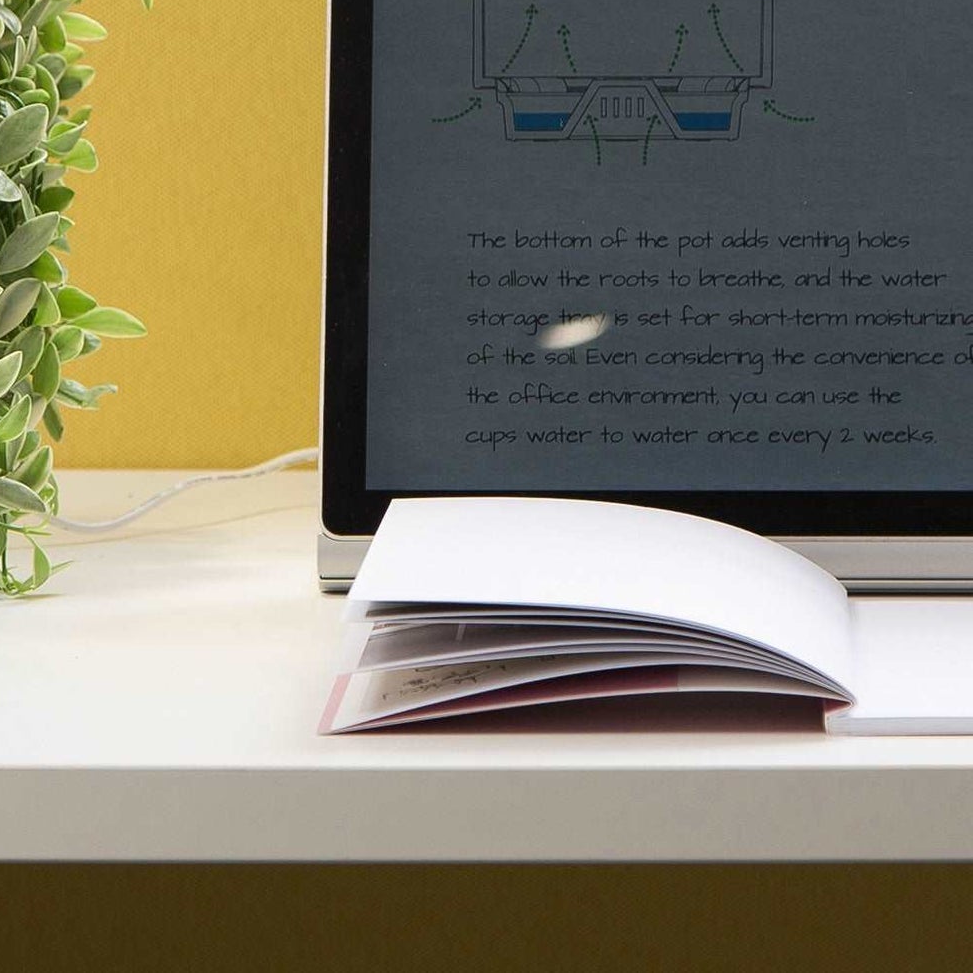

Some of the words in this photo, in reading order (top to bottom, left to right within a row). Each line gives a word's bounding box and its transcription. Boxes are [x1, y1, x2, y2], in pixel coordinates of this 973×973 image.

[467, 232, 506, 248] The
[515, 229, 592, 249] bottom
[600, 227, 627, 248] of
[635, 231, 669, 248] the
[679, 231, 713, 257] pot
[722, 228, 768, 248] adds
[778, 231, 850, 258] venting
[858, 231, 909, 248] holes
[468, 270, 490, 287] to
[498, 269, 548, 287] allow
[557, 267, 590, 287] the
[599, 270, 659, 287] roots
[668, 269, 690, 287] to
[699, 268, 785, 289] breathe,
[795, 267, 830, 287] and
[839, 269, 872, 287] the
[881, 270, 947, 287] water
[467, 308, 549, 336] storage
[614, 308, 629, 326] is
[638, 308, 672, 326] set
[680, 305, 720, 326] for
[729, 309, 847, 326] short-term
[467, 343, 494, 365] of
[502, 347, 535, 365] the
[586, 348, 637, 365] Even
[645, 344, 763, 375] considering
[771, 348, 805, 365] the
[814, 348, 944, 365] convenience
[466, 387, 499, 404] the
[509, 383, 579, 404] office
[588, 387, 719, 406] environment,
[729, 392, 767, 413] you
[776, 391, 815, 404] can
[823, 391, 859, 404] use
[869, 387, 902, 404] the
[465, 430, 517, 451] cups
[526, 426, 592, 444] water
[600, 426, 623, 444] to
[632, 426, 698, 444] water
[708, 430, 759, 444] once
[768, 430, 831, 453] every
[840, 428, 854, 444] 2
[864, 425, 937, 444] weeks.
